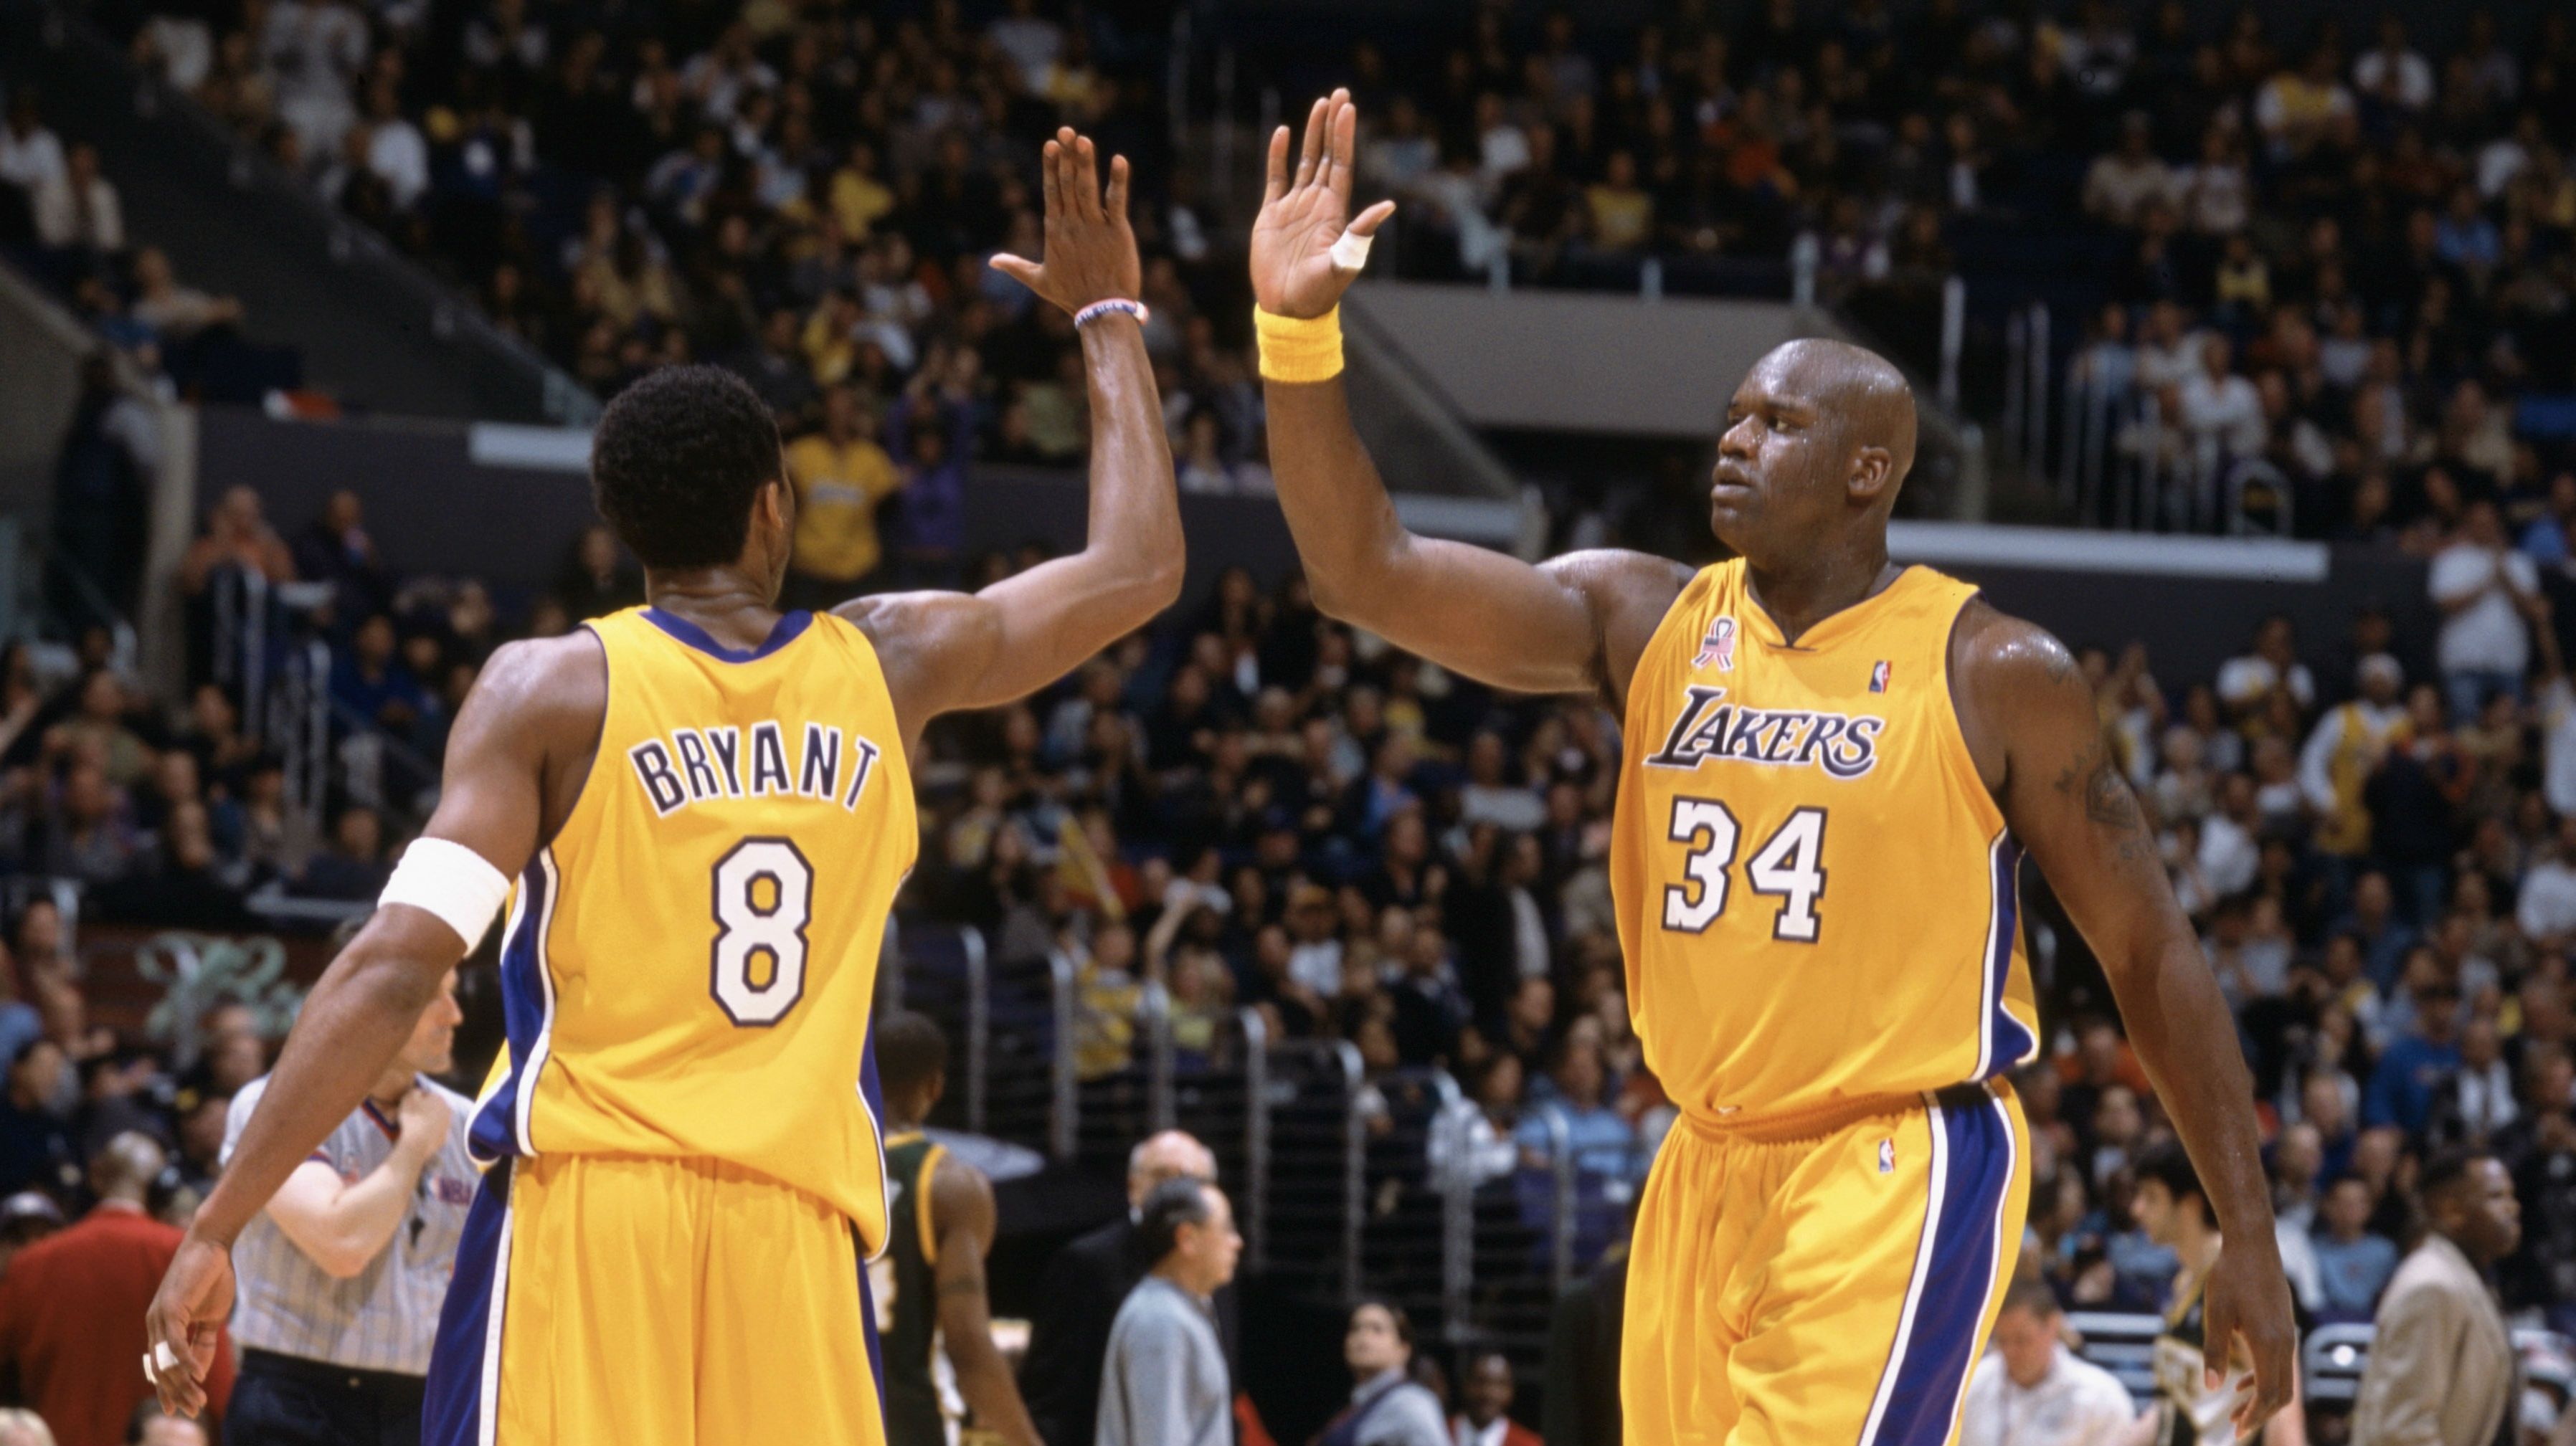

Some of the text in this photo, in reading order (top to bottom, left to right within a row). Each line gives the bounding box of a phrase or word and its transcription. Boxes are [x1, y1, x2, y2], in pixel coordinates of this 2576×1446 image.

[628, 720, 879, 817] BRYANT
[1643, 684, 1884, 779] LAKERS
[1661, 794, 1829, 943] 34
[709, 835, 815, 1027] 8
